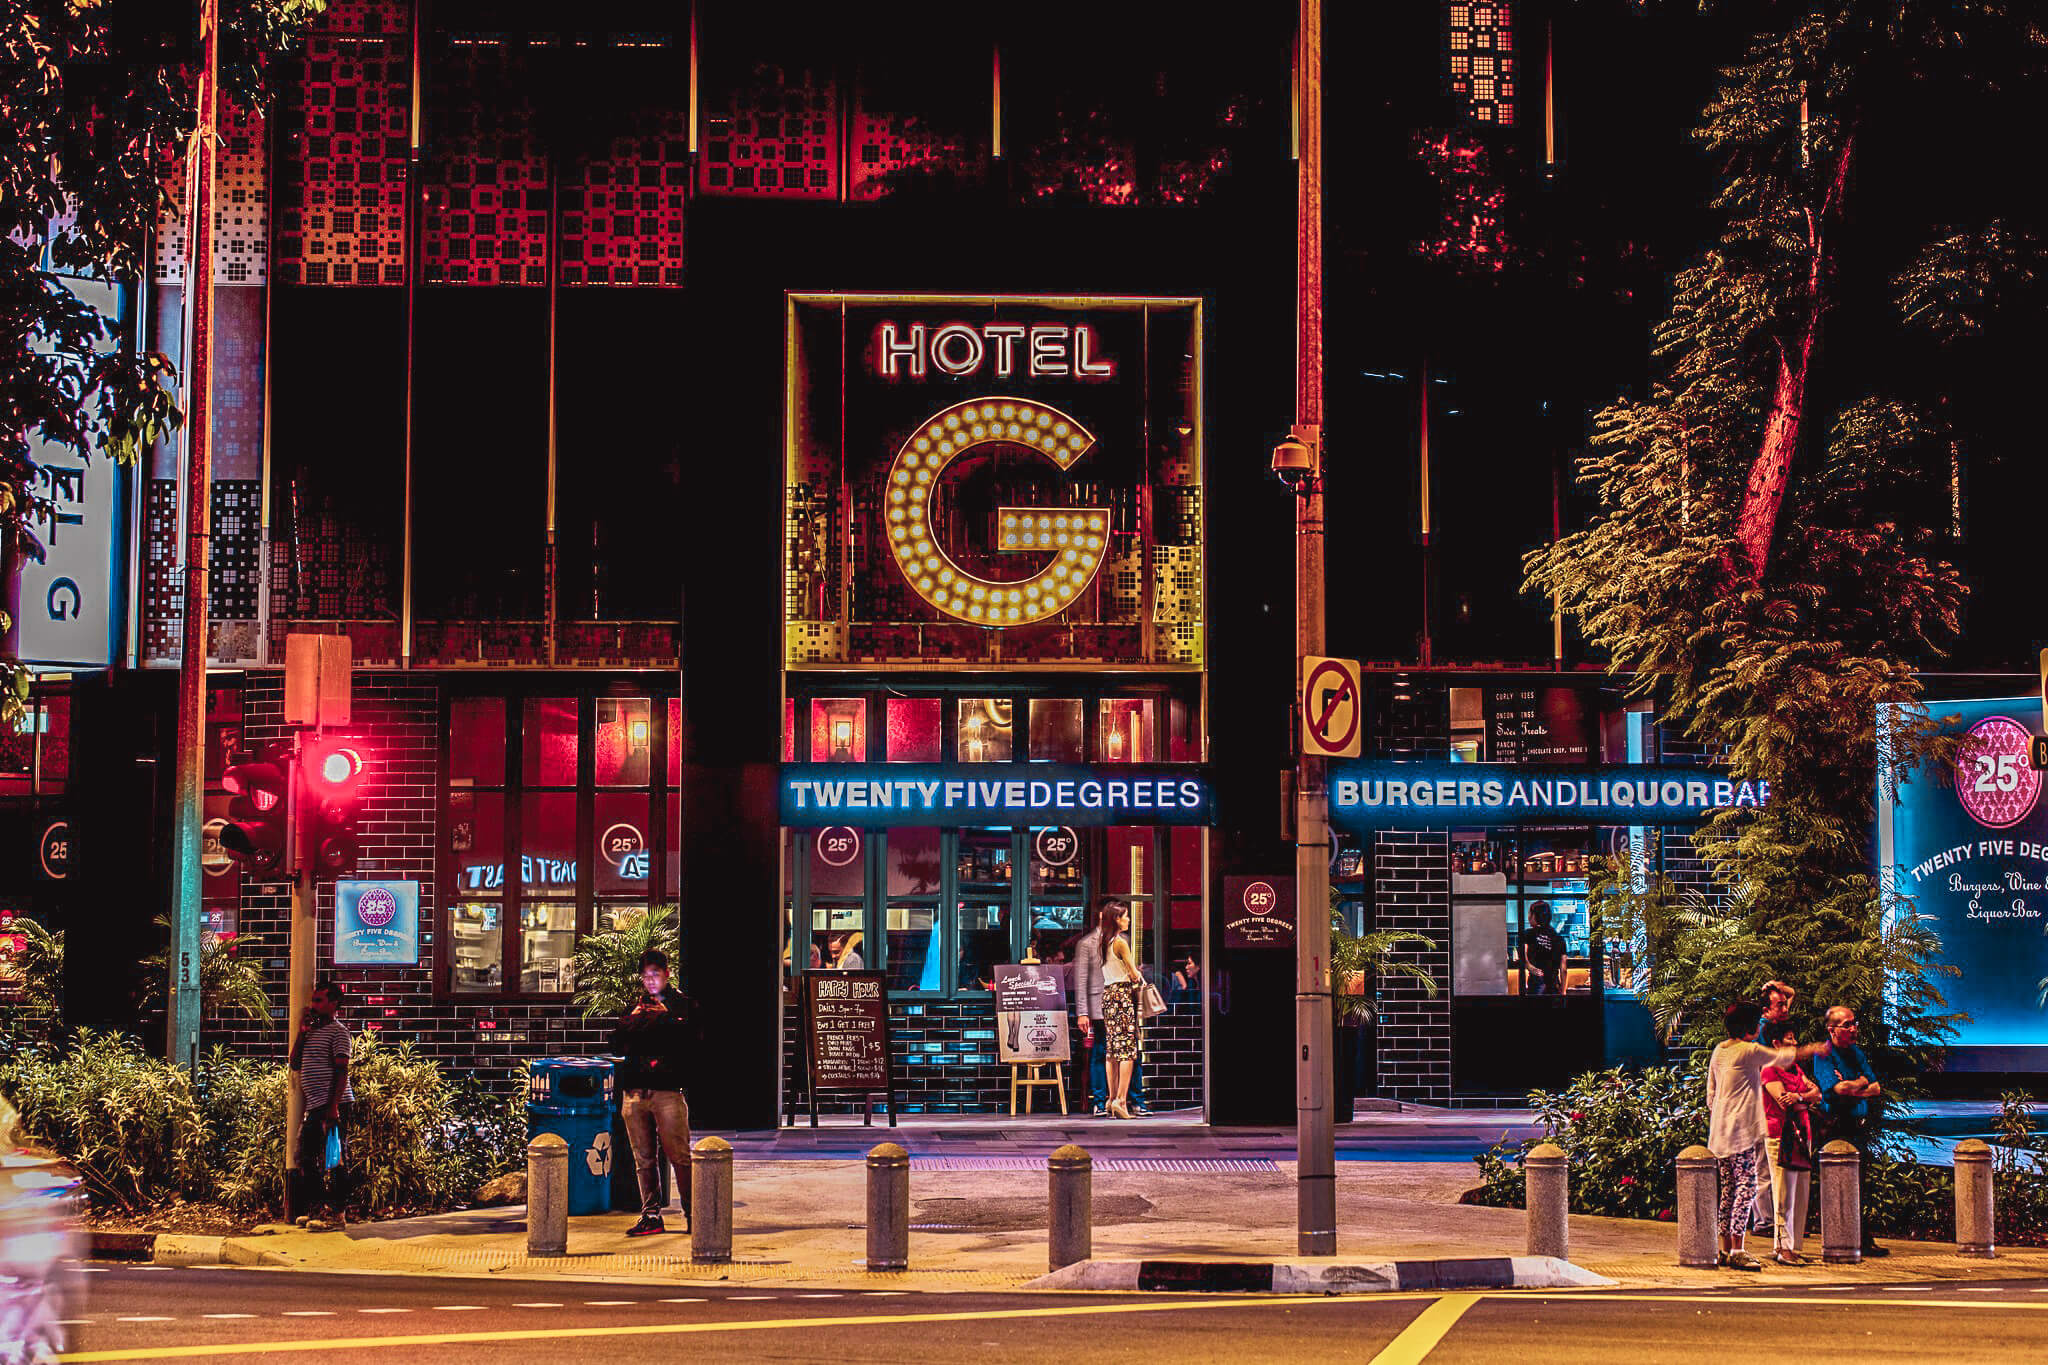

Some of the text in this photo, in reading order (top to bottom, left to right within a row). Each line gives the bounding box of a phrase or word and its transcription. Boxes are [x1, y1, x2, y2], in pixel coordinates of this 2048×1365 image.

[882, 325, 1112, 376] HOTEL
[885, 396, 1111, 626] G
[46, 576, 82, 622] G
[1911, 843, 1973, 883] TWENTY
[1979, 840, 2014, 857] FIVE
[2005, 871, 2042, 891] Wine
[1967, 898, 2042, 924] Liquor Bar
[818, 980, 880, 998] HAPPY HOUR
